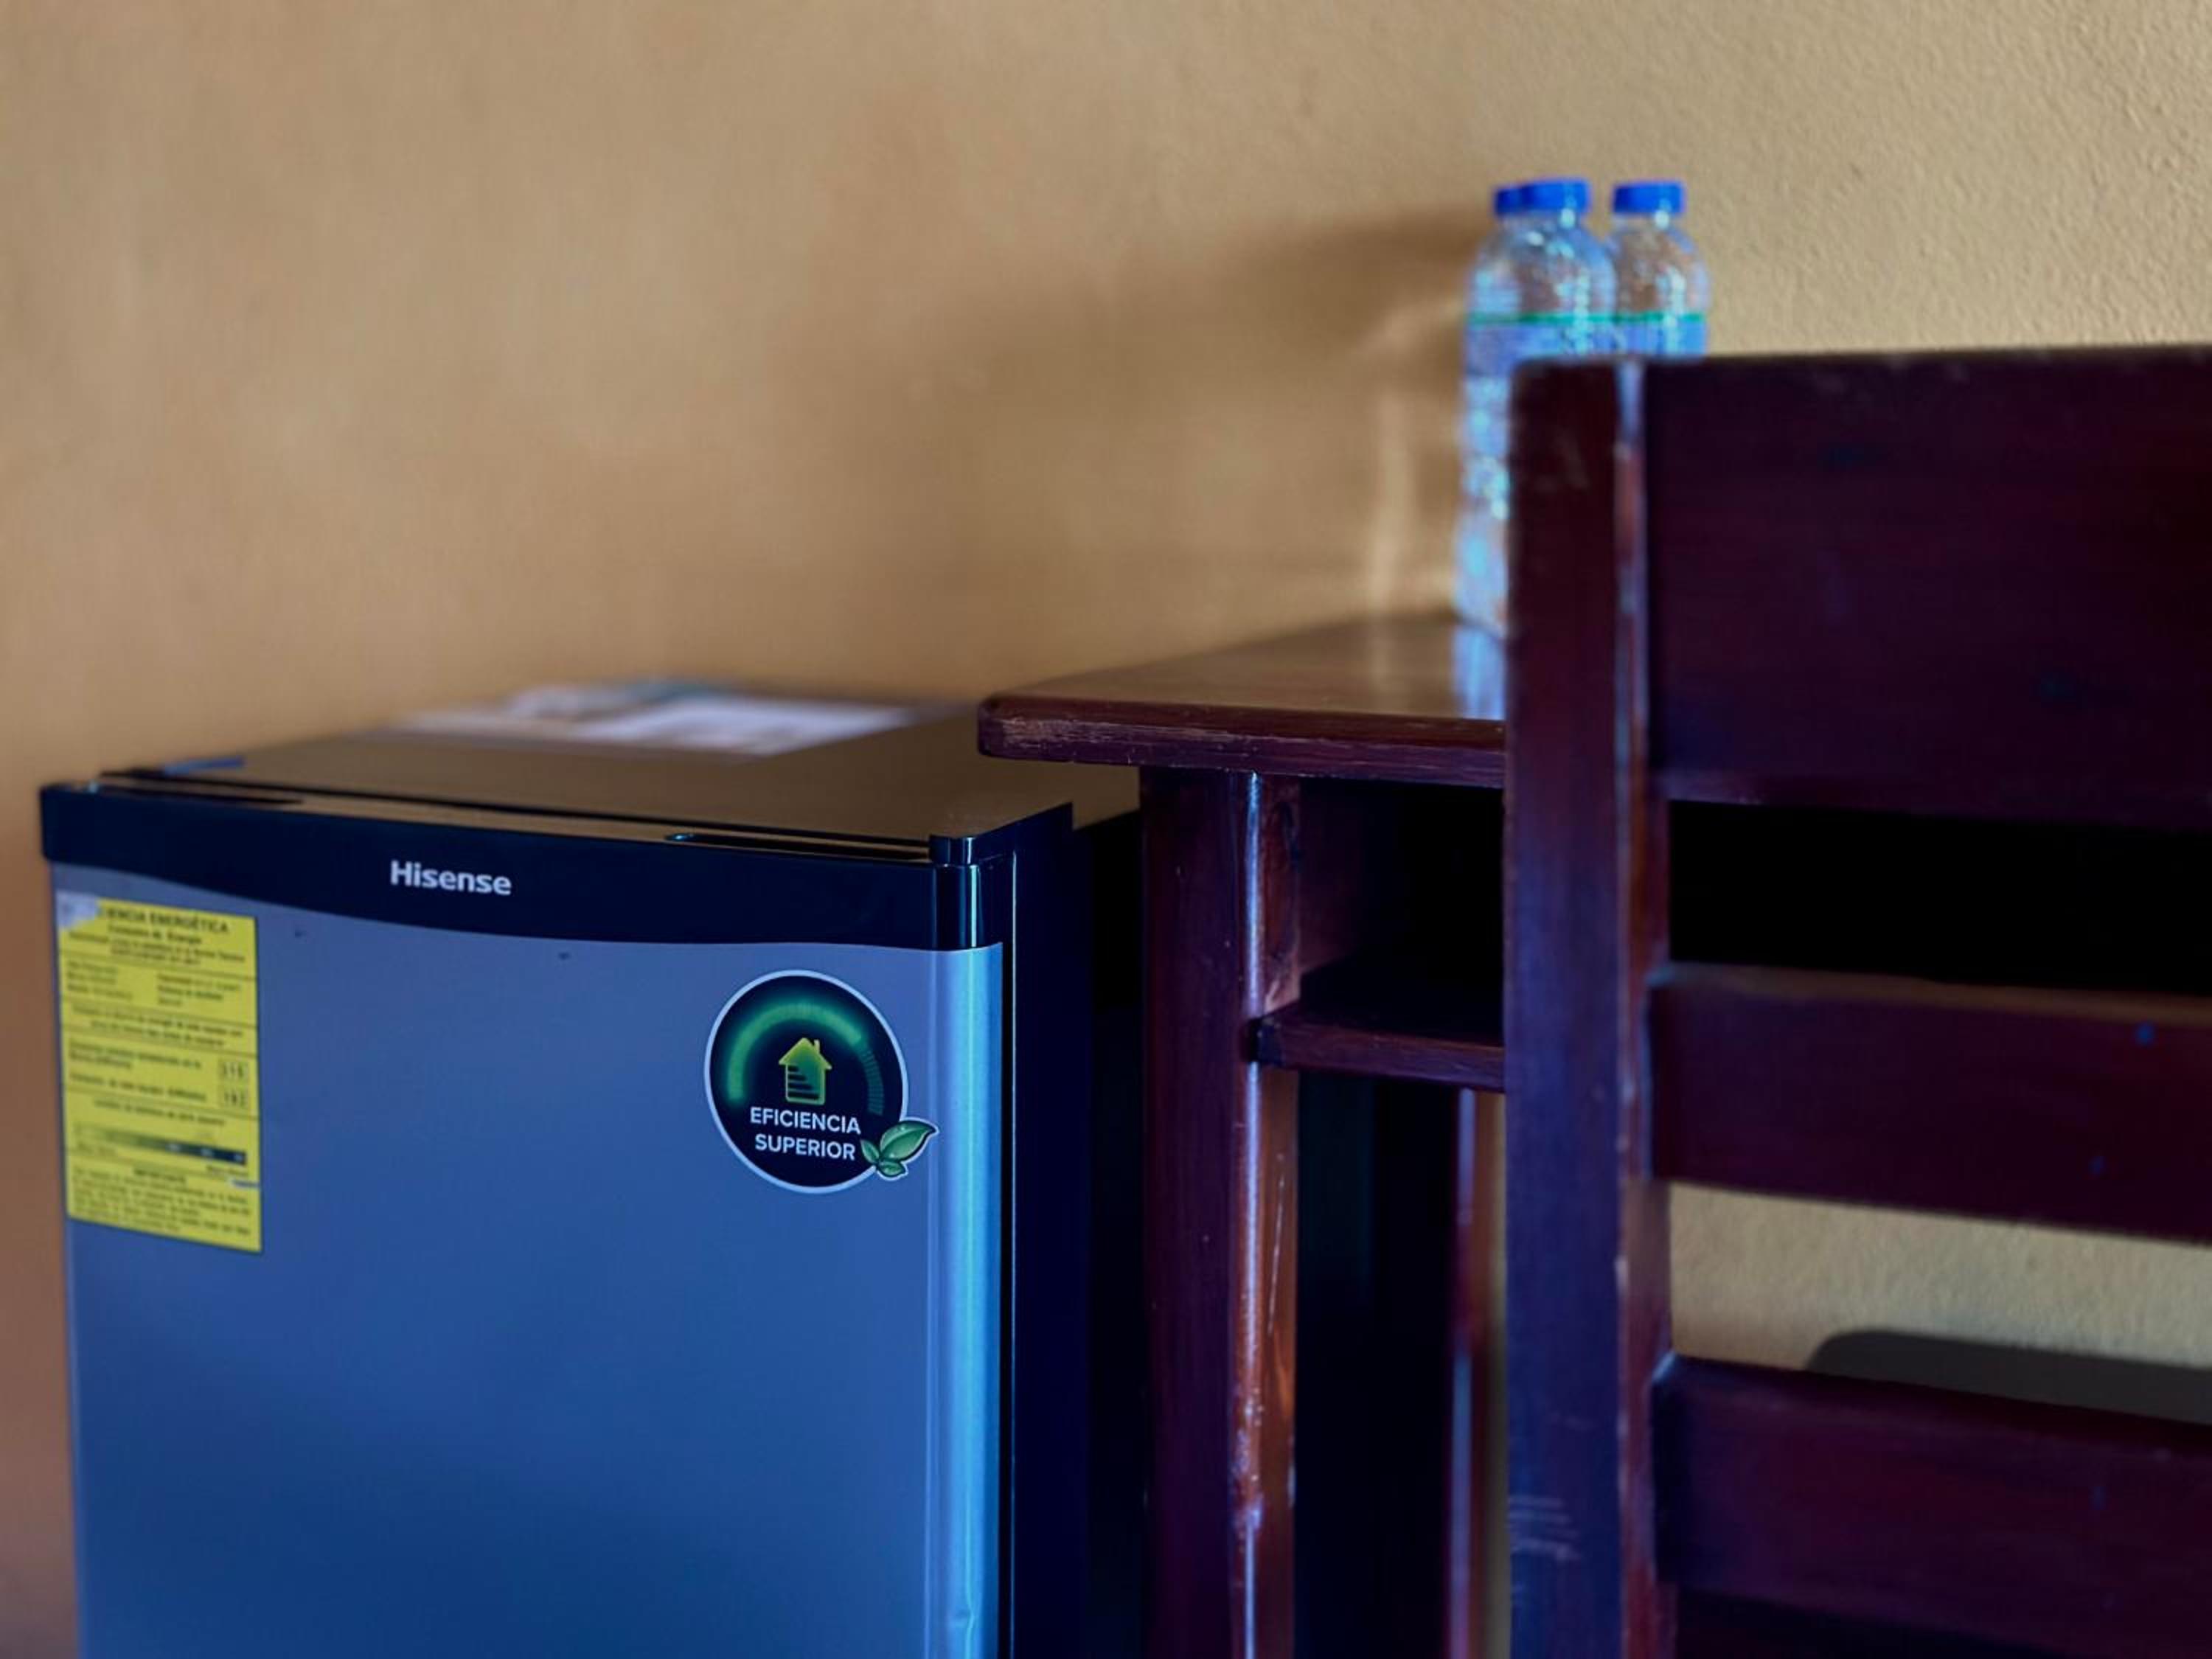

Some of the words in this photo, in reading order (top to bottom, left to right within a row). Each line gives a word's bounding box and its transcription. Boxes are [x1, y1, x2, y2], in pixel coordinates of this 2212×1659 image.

[390, 859, 512, 896] Hisense
[749, 1106, 862, 1135] EFICIENCIA
[754, 1133, 857, 1161] SUPERIOR
